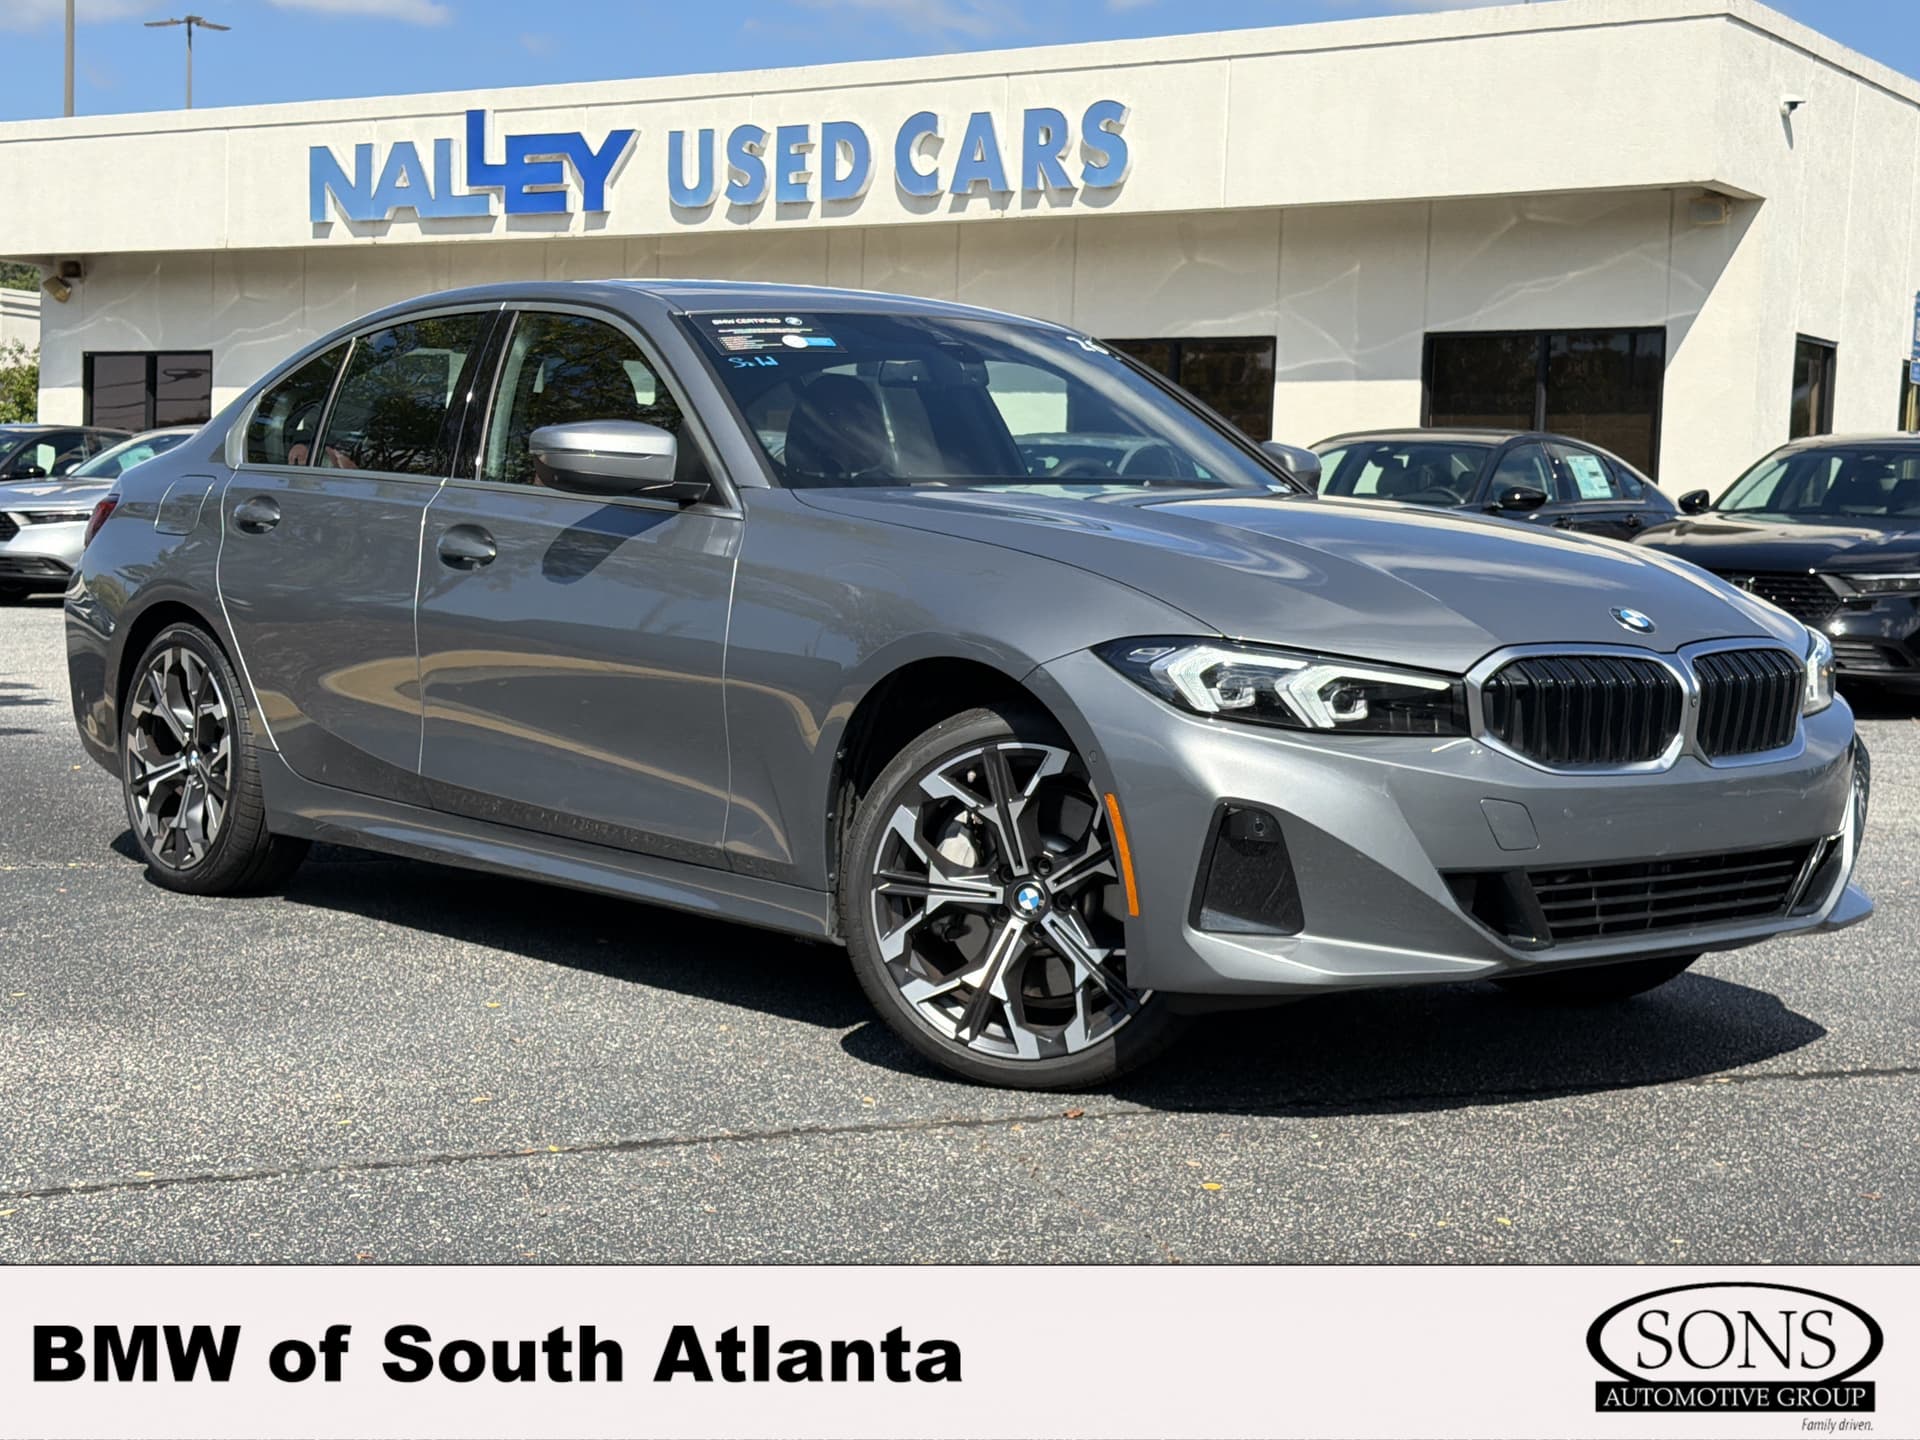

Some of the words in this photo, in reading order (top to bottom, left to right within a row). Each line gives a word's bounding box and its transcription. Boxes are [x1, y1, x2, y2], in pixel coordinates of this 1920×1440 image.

[309, 108, 640, 222] NALLEY
[667, 120, 876, 208] USED
[893, 99, 1131, 197] CARS
